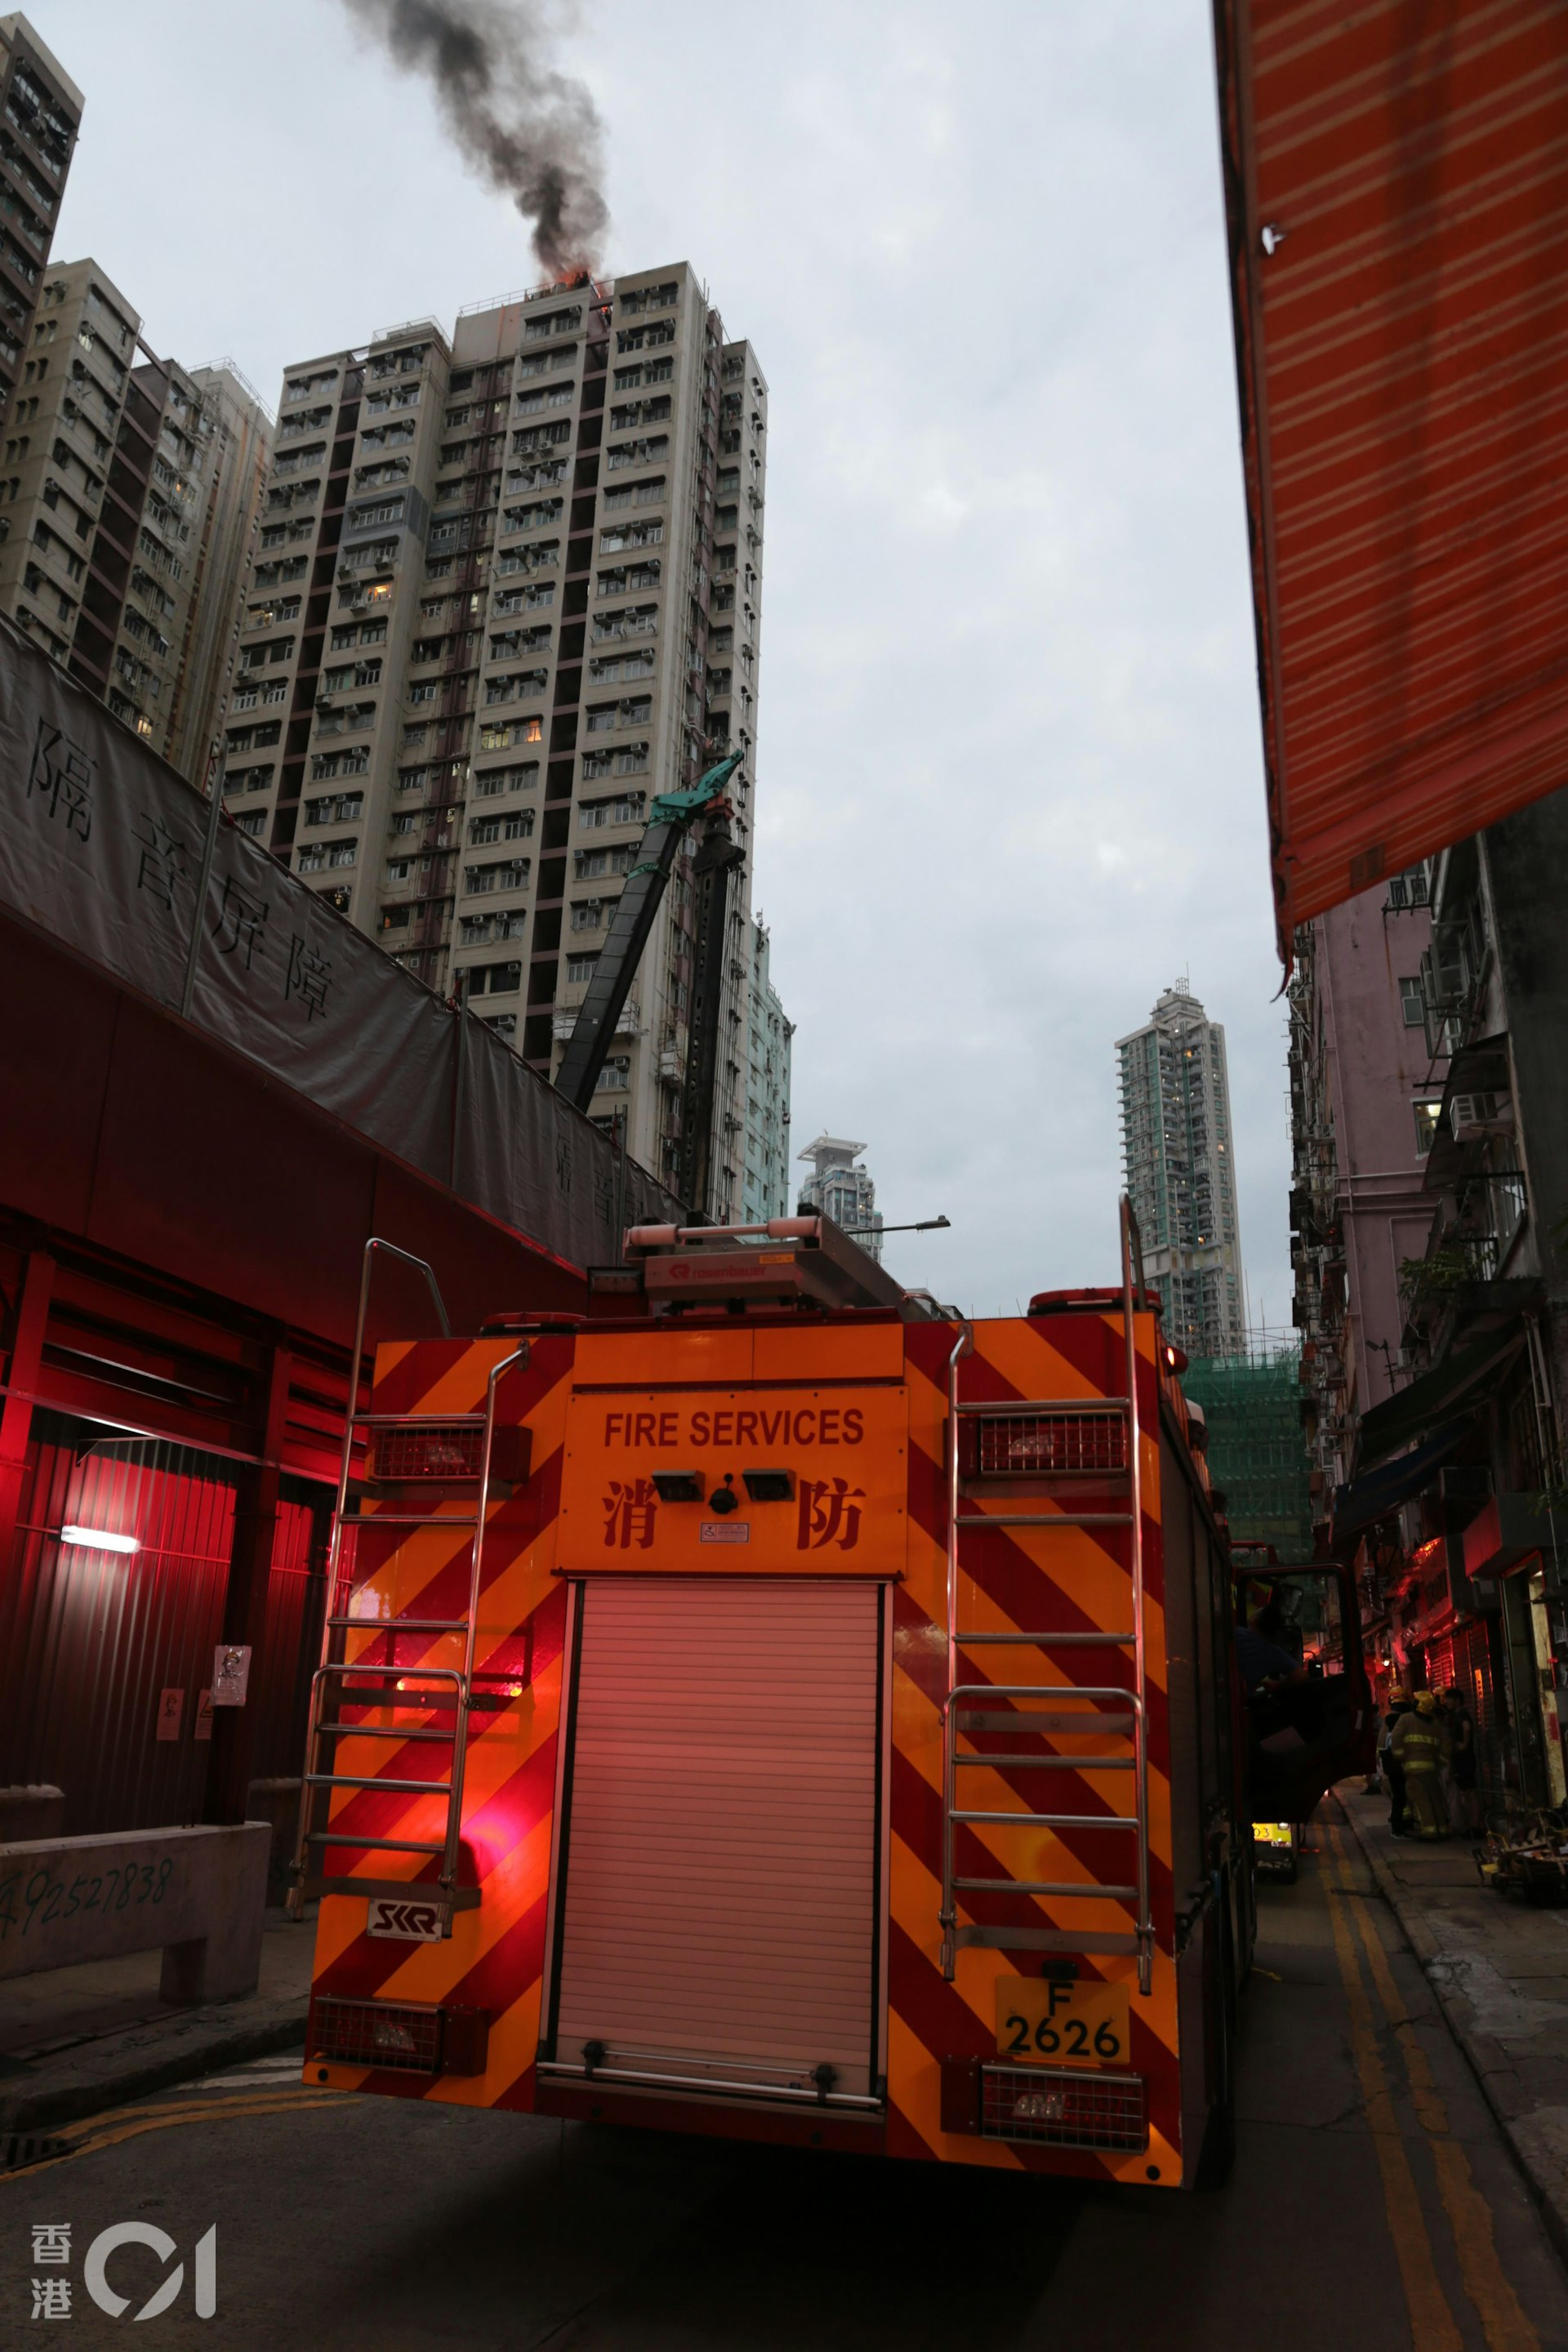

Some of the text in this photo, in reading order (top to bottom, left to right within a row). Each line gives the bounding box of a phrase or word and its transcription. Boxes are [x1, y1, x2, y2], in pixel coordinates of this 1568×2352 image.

[26, 716, 333, 1022] 隔音屏障
[692, 1266, 767, 1279] rosenbauer
[604, 1408, 864, 1447] FIRE SERVICES
[23, 1858, 173, 1936] 92527838
[1049, 1982, 1074, 2016] F
[1005, 2016, 1120, 2058] 2626
